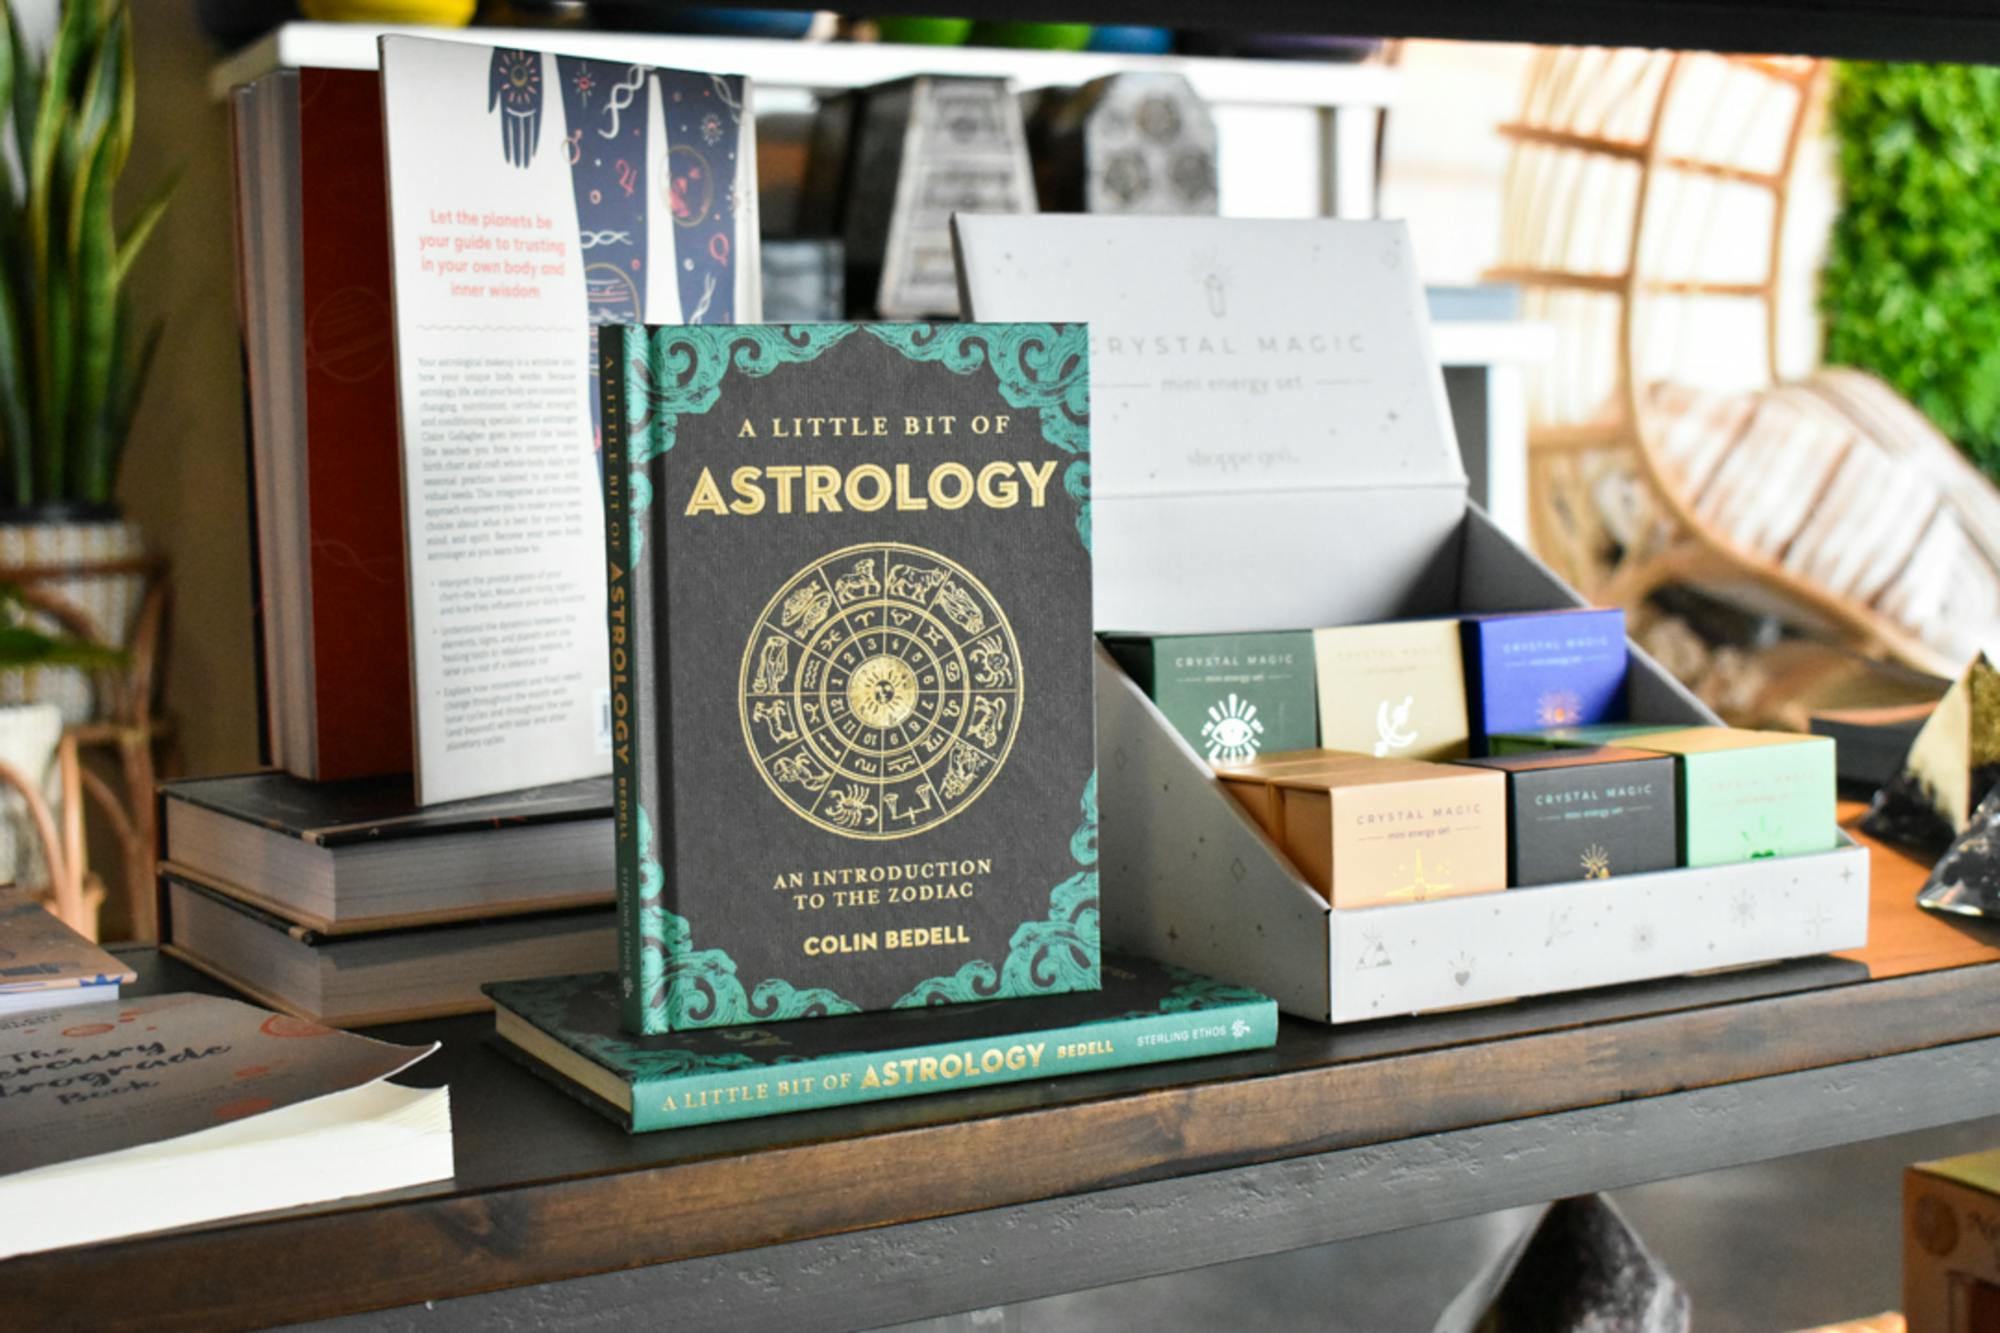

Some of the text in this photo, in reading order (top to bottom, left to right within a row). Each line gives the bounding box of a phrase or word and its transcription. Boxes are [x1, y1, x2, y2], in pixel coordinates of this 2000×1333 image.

[430, 209, 553, 230] Let the planets be
[419, 236, 566, 257] your guide to trusting
[421, 257, 566, 278] in your own body and
[450, 282, 541, 299] inner wisdom
[1259, 334, 1366, 354] MAGIC
[1161, 374, 1303, 397] mini energy set
[738, 415, 1011, 438] A LITTLE BIT OF
[684, 460, 1059, 516] ASTROLOGY
[610, 561, 630, 764] ASTROLOGY
[1175, 654, 1294, 668] CRYSTAL MAGIC
[1535, 784, 1653, 807] CRYSTAL MAGIC
[618, 777, 628, 841] BEDELL
[1356, 803, 1482, 827] CRYSTAL MAGIC
[773, 858, 993, 890] AN INTRODUCTION
[793, 882, 974, 911] TO THE ZODIAC
[803, 925, 970, 956] COLIN BEDELL
[4, 1047, 73, 1063] The
[662, 1026, 1228, 1112] A LITTLE BIT OF ASTROLOGY BEDELL STERLING ETHOS
[57, 1079, 161, 1105] Book
